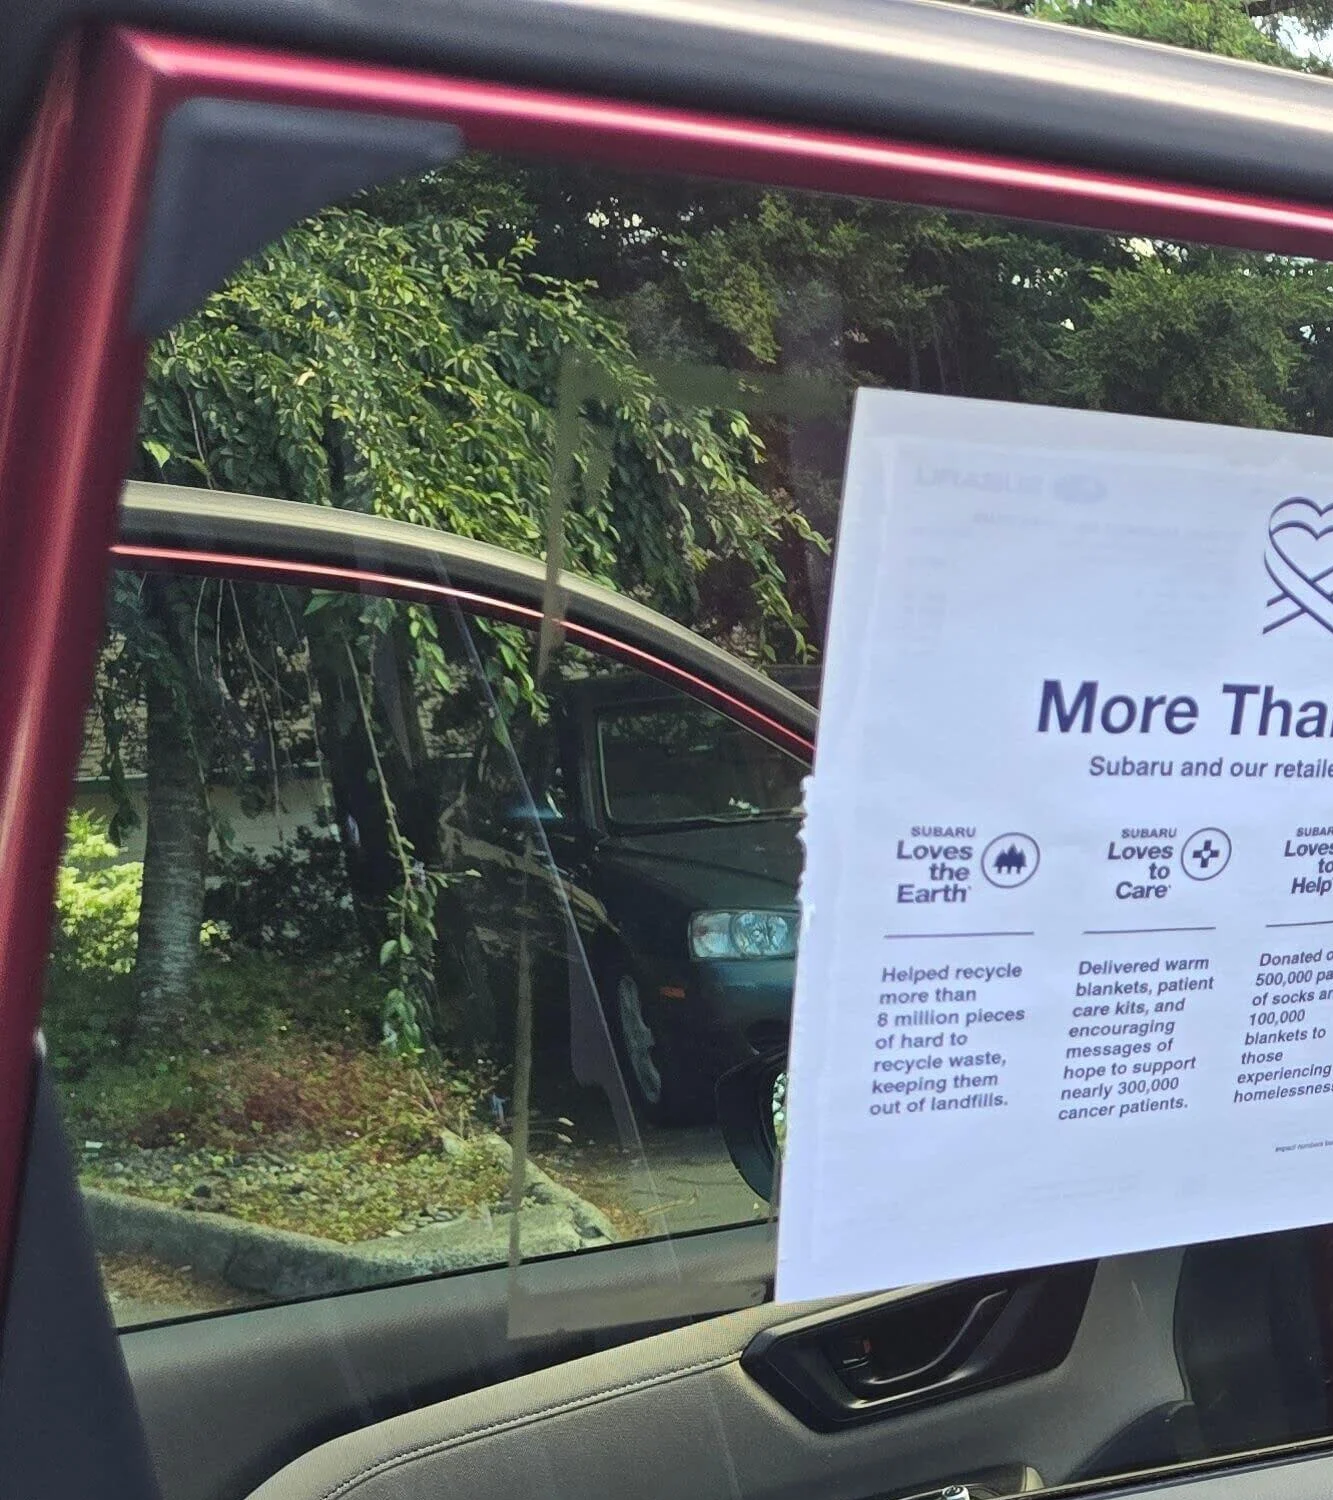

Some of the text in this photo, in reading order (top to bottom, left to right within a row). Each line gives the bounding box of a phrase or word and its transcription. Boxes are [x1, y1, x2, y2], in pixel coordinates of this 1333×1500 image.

[1038, 680, 1198, 734] More
[1090, 756, 1173, 776] Subaru
[1181, 757, 1223, 776] and
[1230, 762, 1268, 776] our
[911, 826, 976, 837] SUBARU
[1121, 828, 1177, 839] SUBARU
[897, 840, 973, 860] Loves
[1108, 842, 1174, 860] Loves
[929, 863, 970, 881] the
[1149, 863, 1170, 880] to
[897, 884, 967, 903] Earth
[1116, 882, 1168, 899] Care
[1291, 877, 1332, 896] Help
[1079, 958, 1208, 975] Delivered warm
[1260, 949, 1323, 967] Donated
[882, 963, 1022, 984] Helped recycle
[1256, 970, 1313, 987] 500,000
[1076, 977, 1214, 996] blankets, patient
[880, 988, 976, 1004] more than
[1252, 992, 1268, 1006] of
[1272, 990, 1315, 1005] socks
[1073, 998, 1185, 1017] care kits, and
[878, 1009, 1024, 1027] 8 million pieces
[1250, 1009, 1305, 1026] 100,000
[1069, 1020, 1175, 1037] encouraging
[1245, 1027, 1326, 1045] blankets to
[876, 1033, 967, 1049] of hard to
[1067, 1038, 1174, 1058] messages of
[874, 1052, 1006, 1074] recycle waste,
[1242, 1052, 1283, 1064] those
[1064, 1057, 1196, 1081] hope to support
[1238, 1064, 1332, 1085] experiencing
[872, 1074, 998, 1095] keeping them
[1061, 1077, 1178, 1100] nearly 300,000
[870, 1093, 1007, 1115] out of landfills.
[1059, 1097, 1187, 1120] cancer patients.
